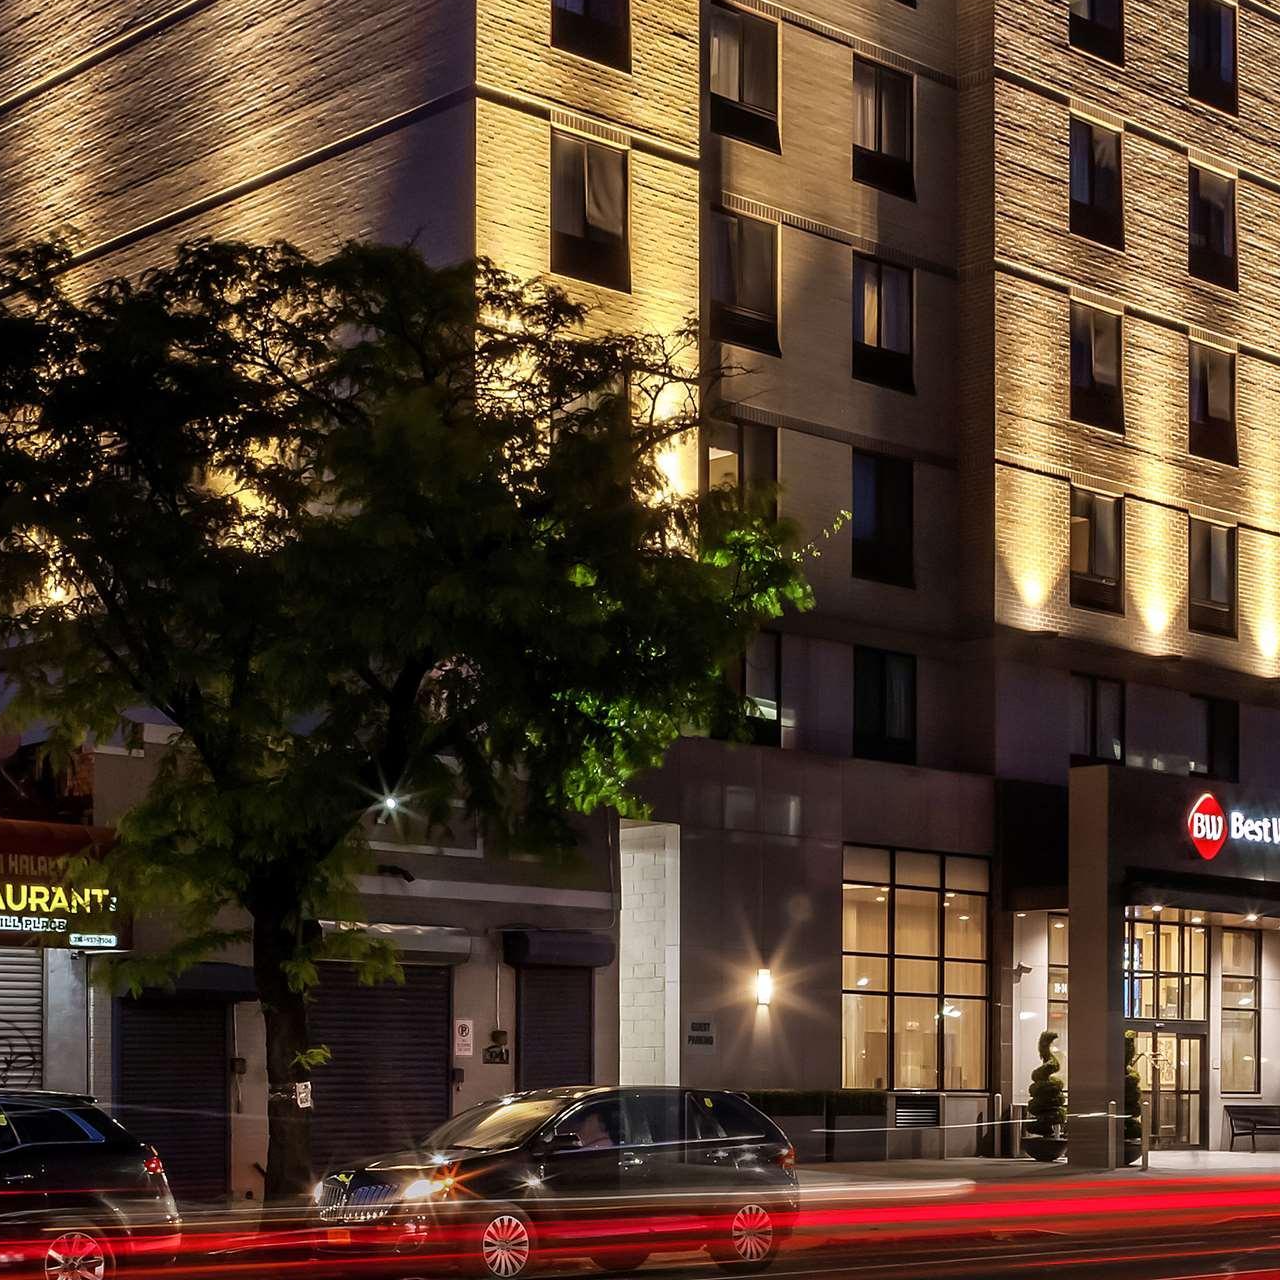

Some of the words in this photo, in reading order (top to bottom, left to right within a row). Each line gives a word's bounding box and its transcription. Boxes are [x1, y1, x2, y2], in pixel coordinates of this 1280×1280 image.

[1192, 812, 1223, 841] BW
[1230, 811, 1272, 844] Best
[22, 916, 67, 932] PLACE
